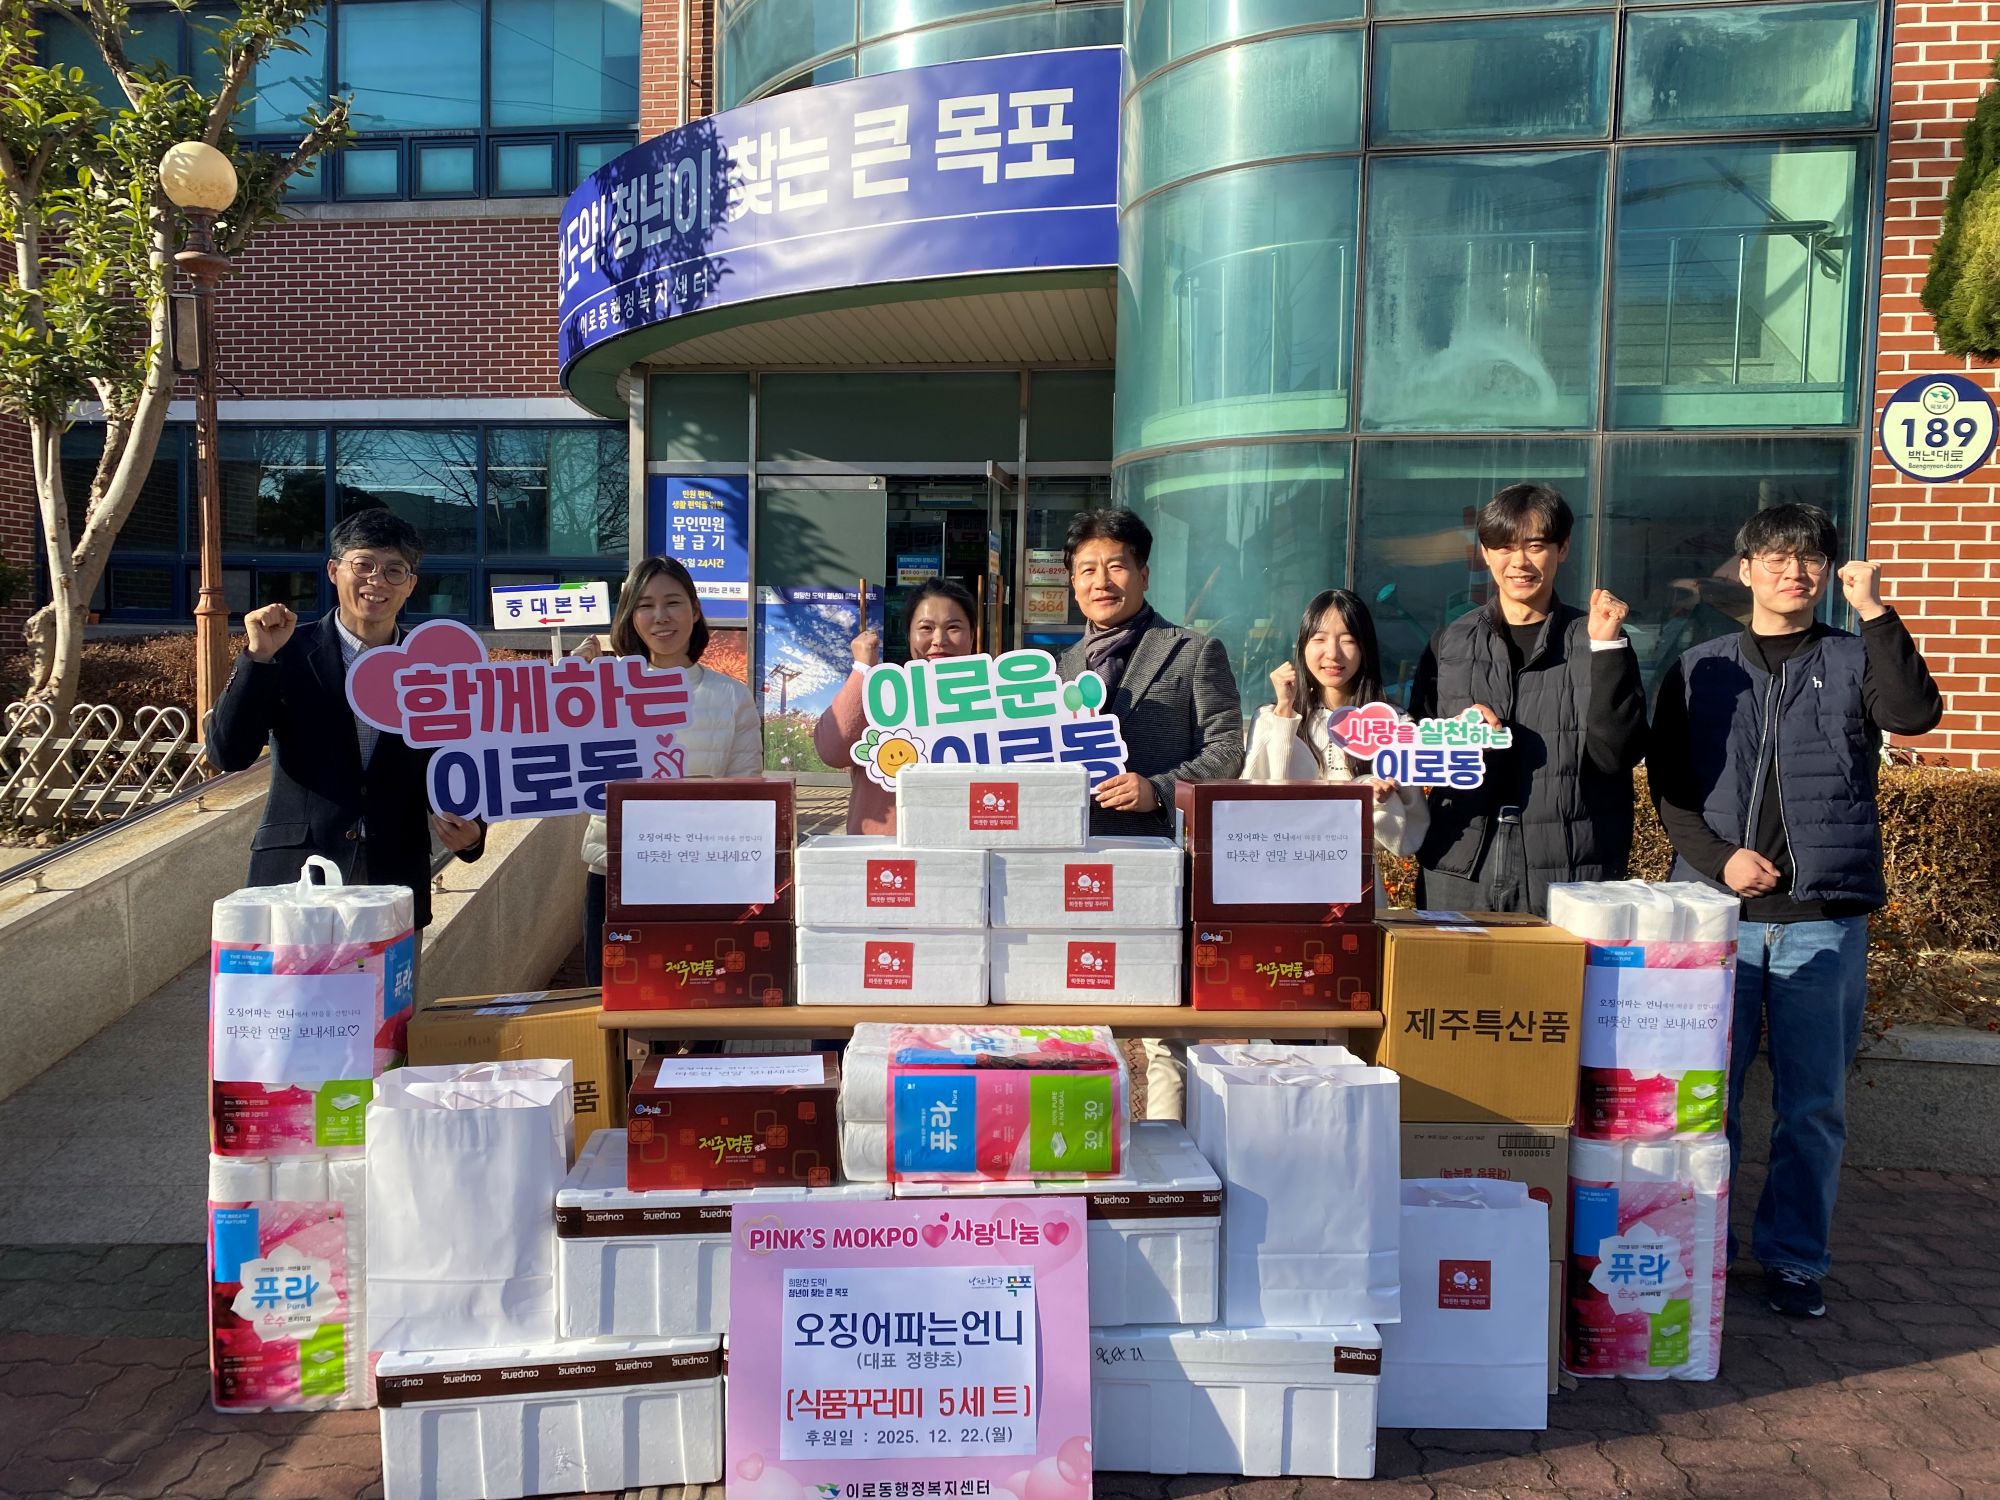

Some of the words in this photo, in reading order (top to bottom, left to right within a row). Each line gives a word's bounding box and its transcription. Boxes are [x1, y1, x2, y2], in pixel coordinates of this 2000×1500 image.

[612, 149, 711, 260] 청년이
[727, 126, 829, 223] 찾는
[852, 104, 911, 199] 큰
[935, 87, 1075, 184] 목포
[580, 264, 708, 339] 이로동행정복지센터
[1900, 417, 1978, 448] 189
[1908, 450, 1963, 462] 백년대로
[672, 516, 725, 533] 무인민원
[697, 558, 725, 569] 24시간
[1028, 600, 1064, 612] 5364
[868, 654, 1057, 728] 이로운
[400, 661, 689, 743] 함께하는
[1346, 718, 1415, 745] 사랑을
[1419, 721, 1510, 746] 실천하는
[1376, 749, 1482, 786] 이로동
[433, 739, 643, 818] 이로동
[638, 833, 681, 842] 오징어파는
[1227, 832, 1268, 842] 오징어파는
[637, 850, 672, 863] 따뜻한
[678, 850, 700, 863] 연말
[1226, 849, 1260, 863] 따뜻한
[1265, 849, 1288, 863] 연말
[665, 960, 714, 986] 제주명품
[1256, 961, 1304, 988] 제주명품
[226, 1008, 271, 1019] 오징어파는
[1600, 1000, 1642, 1009] 오징어파는
[226, 1025, 262, 1040] 따뜻한
[268, 1025, 292, 1040] 연말
[1404, 1008, 1570, 1043] 제주특산품
[1598, 1016, 1631, 1030] 따뜻한
[1638, 1016, 1658, 1030] 연말
[1084, 1100, 1098, 1121] 30
[930, 1100, 958, 1154] 퓨라
[699, 1135, 753, 1164] 제주명품
[1084, 1130, 1098, 1150] 30
[1094, 1195, 1130, 1204] coupang
[1148, 1194, 1184, 1204] coupang
[586, 1212, 624, 1222] coupang
[644, 1210, 680, 1220] coupang
[700, 1209, 732, 1218] oupang
[750, 1227, 826, 1250] PINK'S
[832, 1227, 918, 1249] MOKPO
[950, 1217, 1040, 1247] 사랑나눔
[1608, 1253, 1670, 1284] 퓨라
[251, 1274, 320, 1310] 퓨라
[788, 1278, 810, 1288] 희망찬
[811, 1278, 828, 1288] 도약!
[788, 1288, 809, 1298] 청년이
[810, 1288, 825, 1298] 찾는
[826, 1288, 834, 1298] 큰
[835, 1288, 849, 1298] 목포
[1006, 1276, 1032, 1297] 목포
[286, 1302, 306, 1312] Pura
[794, 1310, 1024, 1349] 오징어파는언니
[856, 1351, 897, 1370] (대표
[906, 1350, 963, 1370] 정향초)
[1340, 1350, 1377, 1361] coupang
[443, 1374, 482, 1384] coupang
[501, 1369, 539, 1380] coupang
[558, 1365, 596, 1376] coupang
[616, 1361, 653, 1371] coupang
[672, 1356, 709, 1366] coupang
[805, 1430, 854, 1446] 후원일
[877, 1430, 919, 1444] 2025.
[928, 1429, 952, 1444] 12.
[960, 1426, 1013, 1444] 22.(월)
[846, 1479, 991, 1500] 이로동행정복지센터
